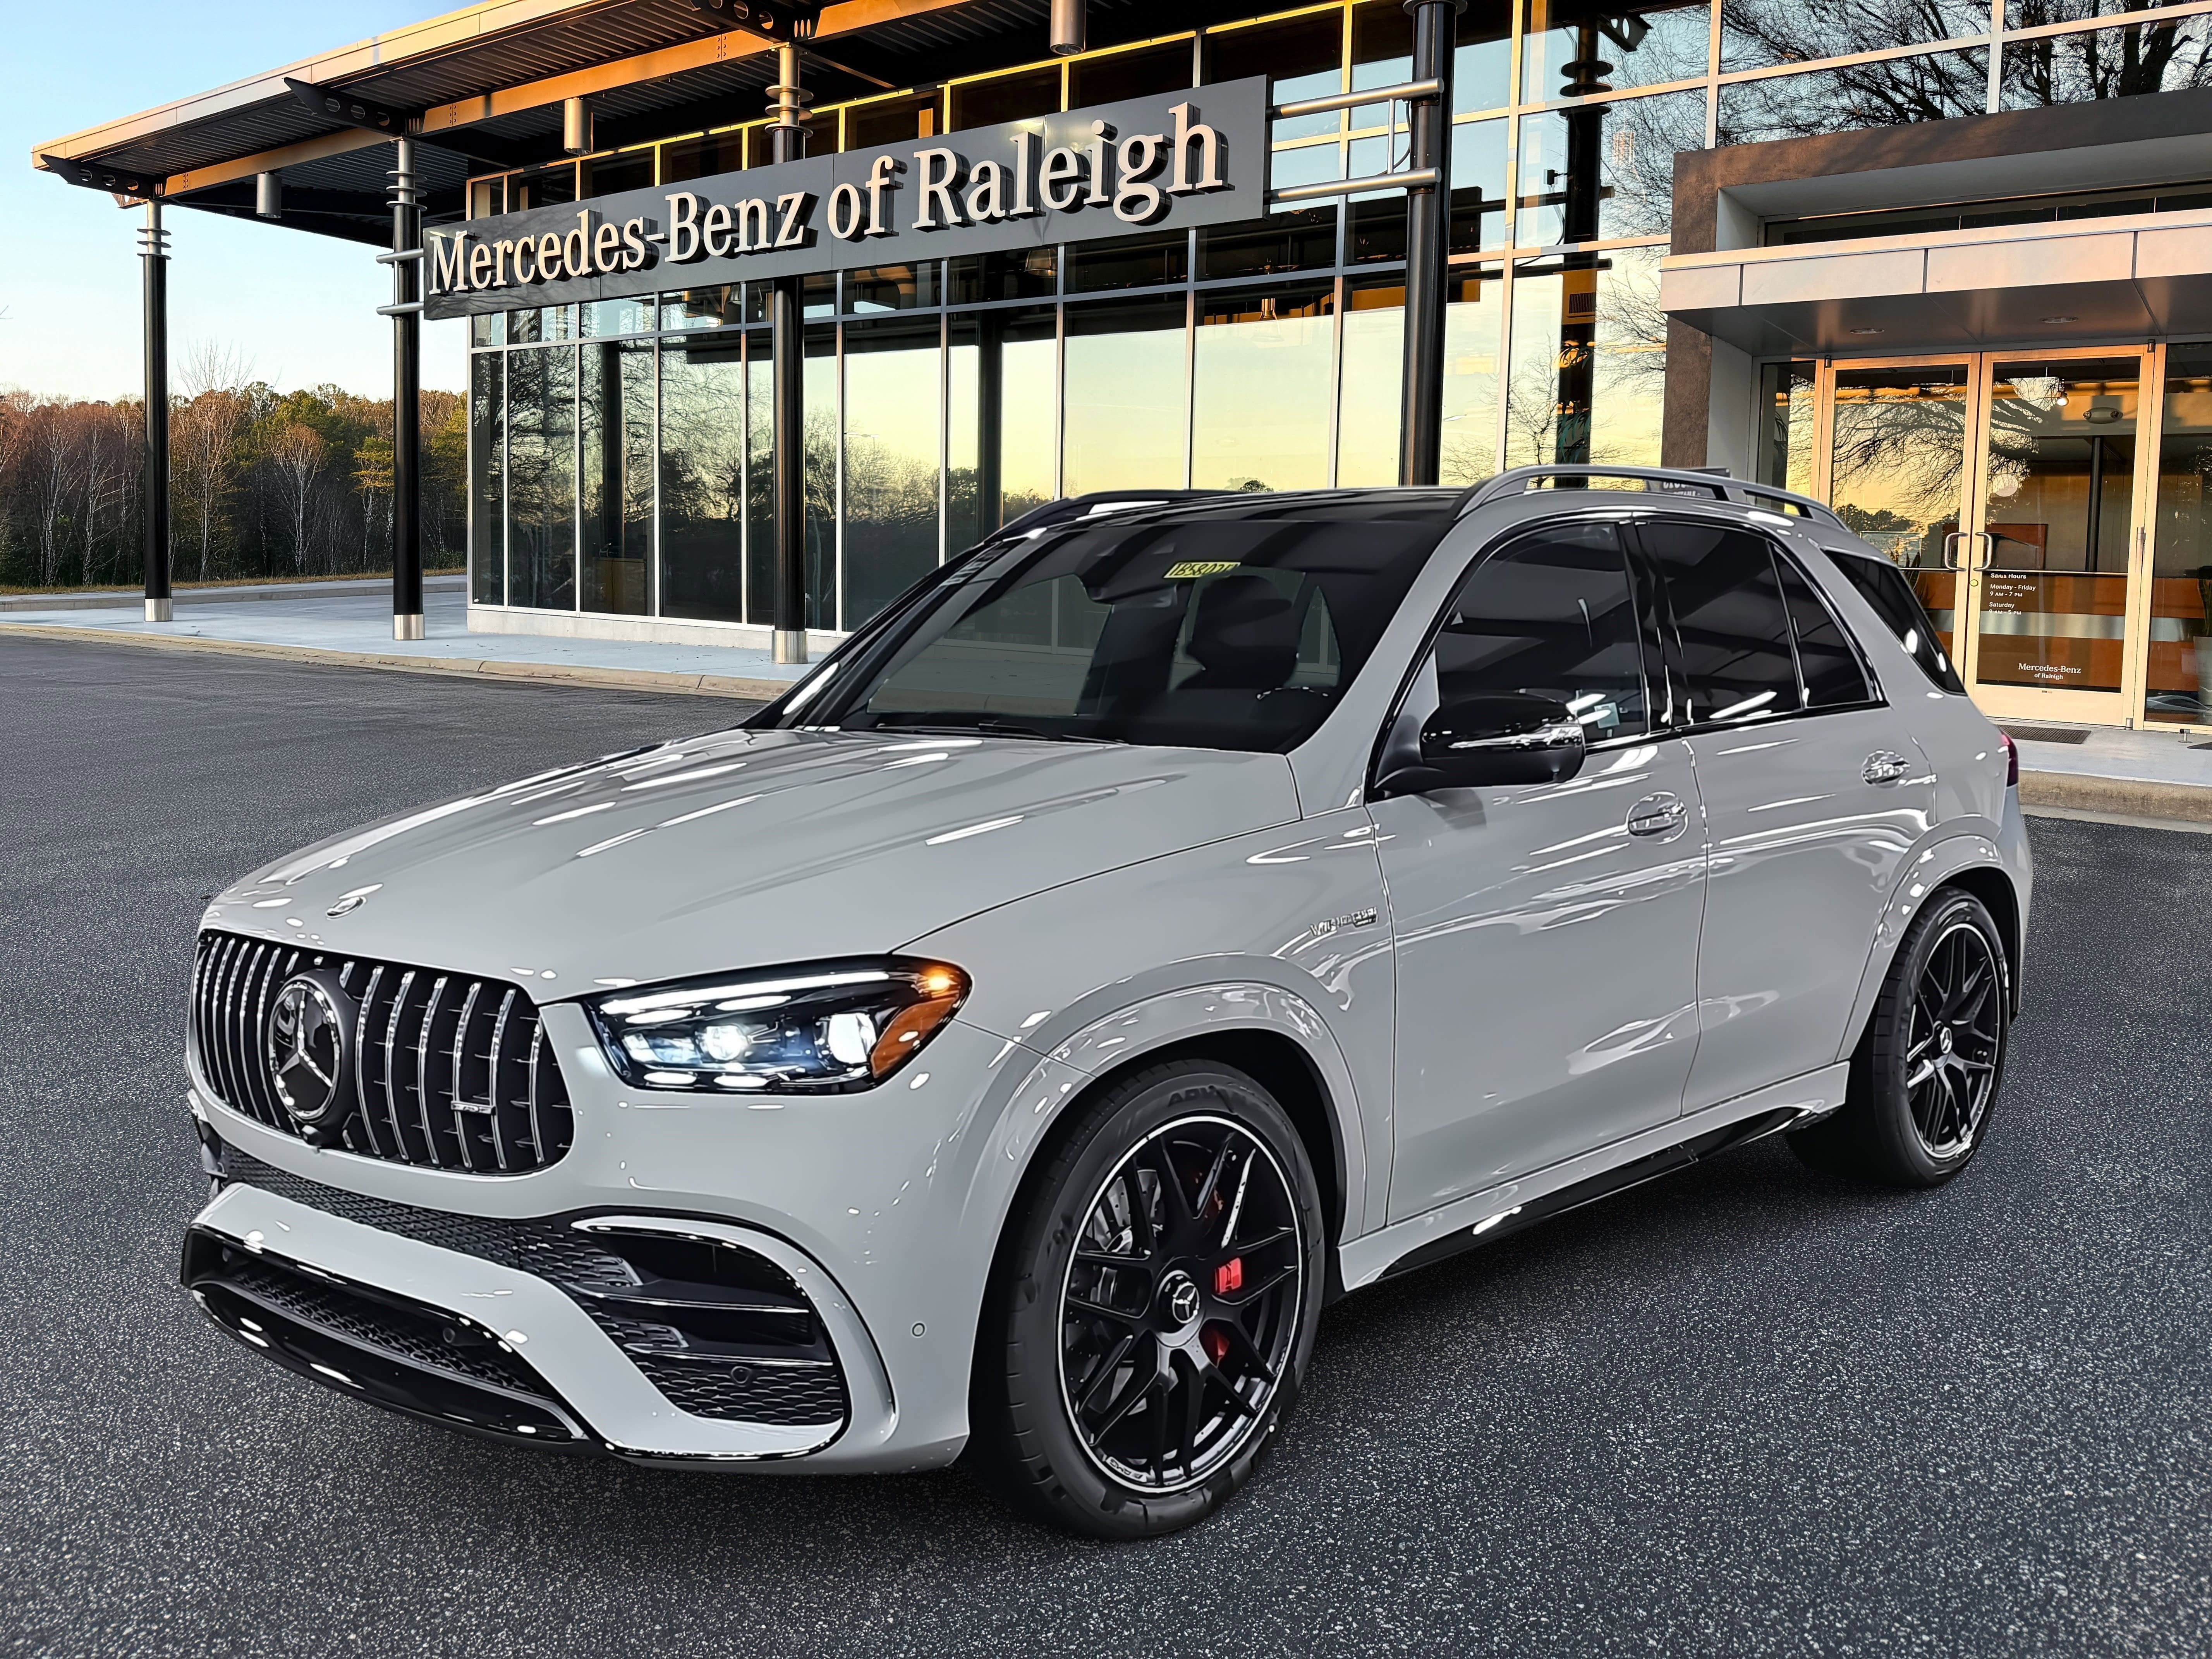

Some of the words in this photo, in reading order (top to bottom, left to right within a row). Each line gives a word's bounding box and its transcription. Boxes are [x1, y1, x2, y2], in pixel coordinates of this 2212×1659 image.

[429, 191, 806, 295] Mercedes-Benz
[827, 155, 893, 239] of
[912, 101, 1223, 222] Raleigh
[2018, 663, 2081, 673] Mercedes-Benz
